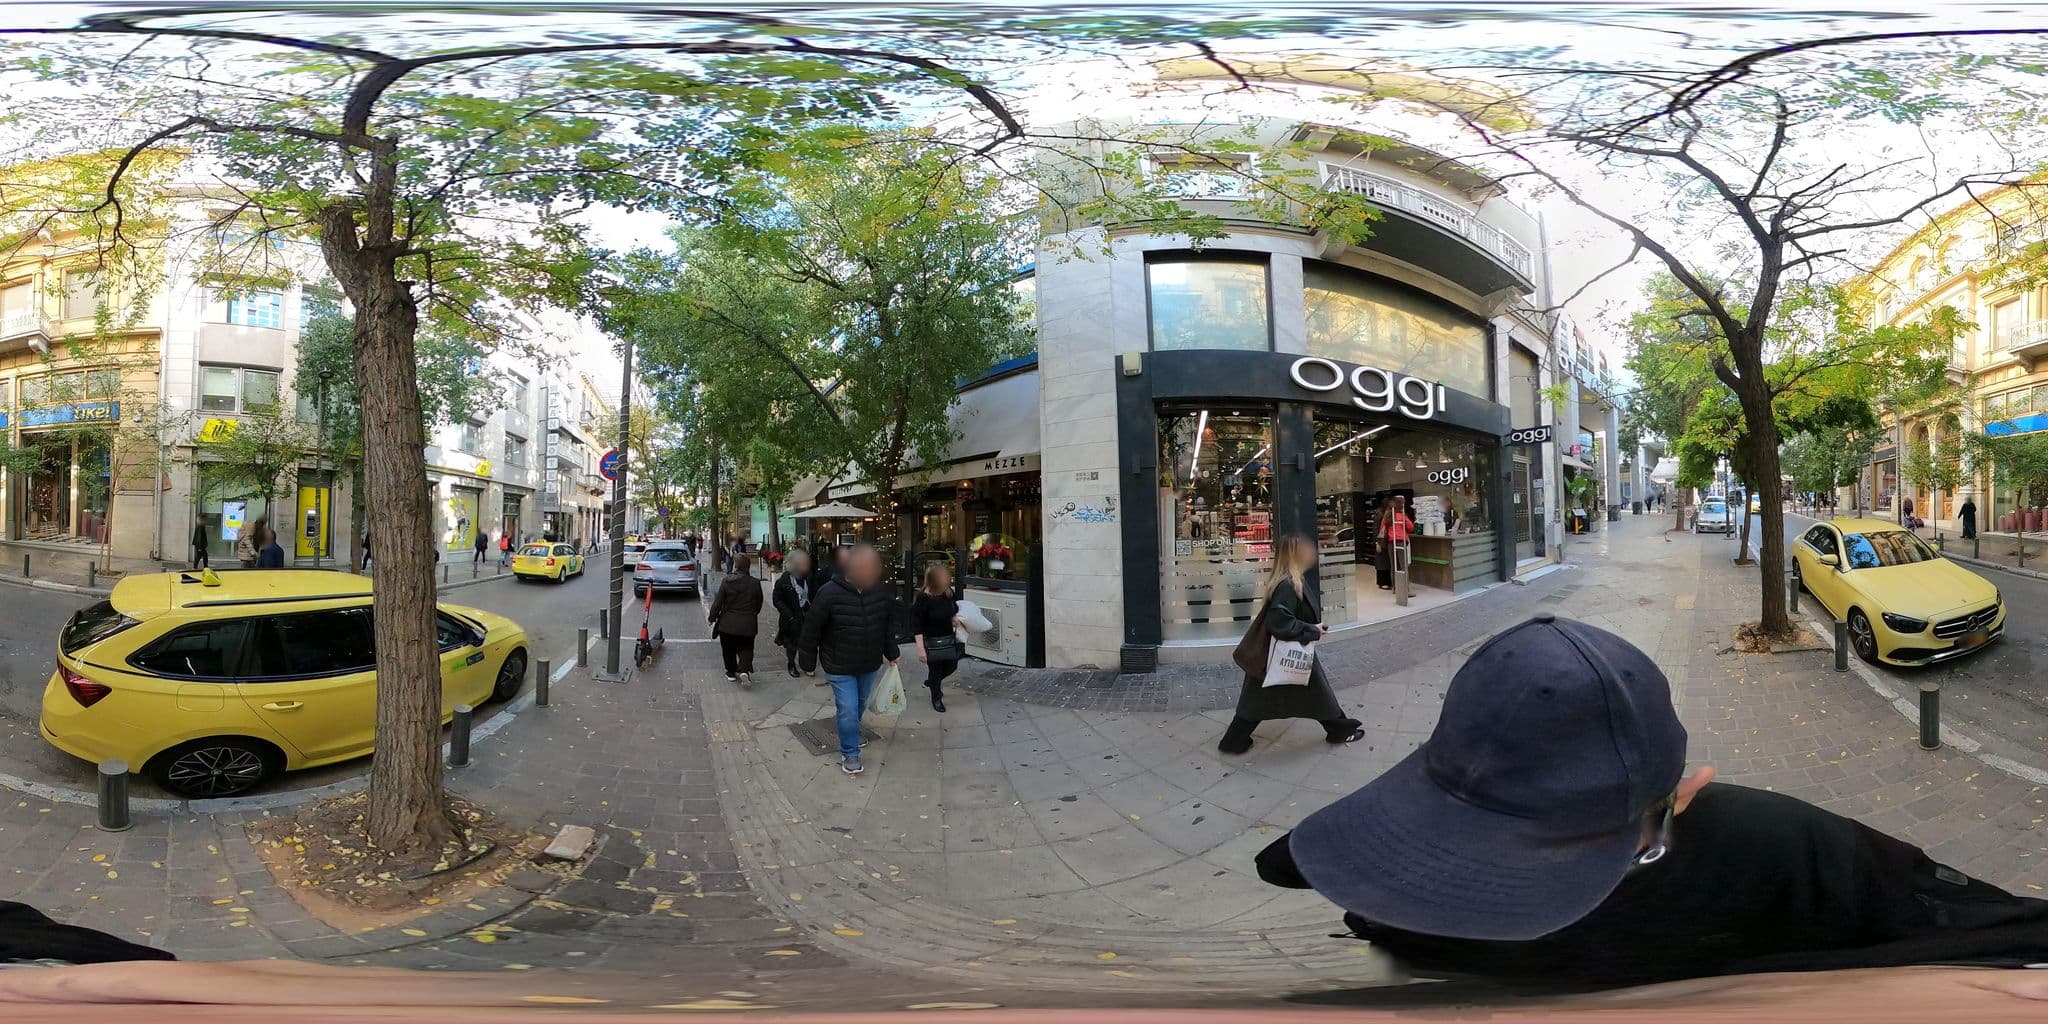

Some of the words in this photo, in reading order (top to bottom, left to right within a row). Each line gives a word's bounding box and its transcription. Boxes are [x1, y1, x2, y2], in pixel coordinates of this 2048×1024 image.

[1290, 357, 1446, 420] oggi
[1511, 426, 1550, 443] oggi
[984, 456, 1025, 471] MEZZE
[1427, 466, 1469, 486] oggi
[1192, 539, 1215, 547] SHOP
